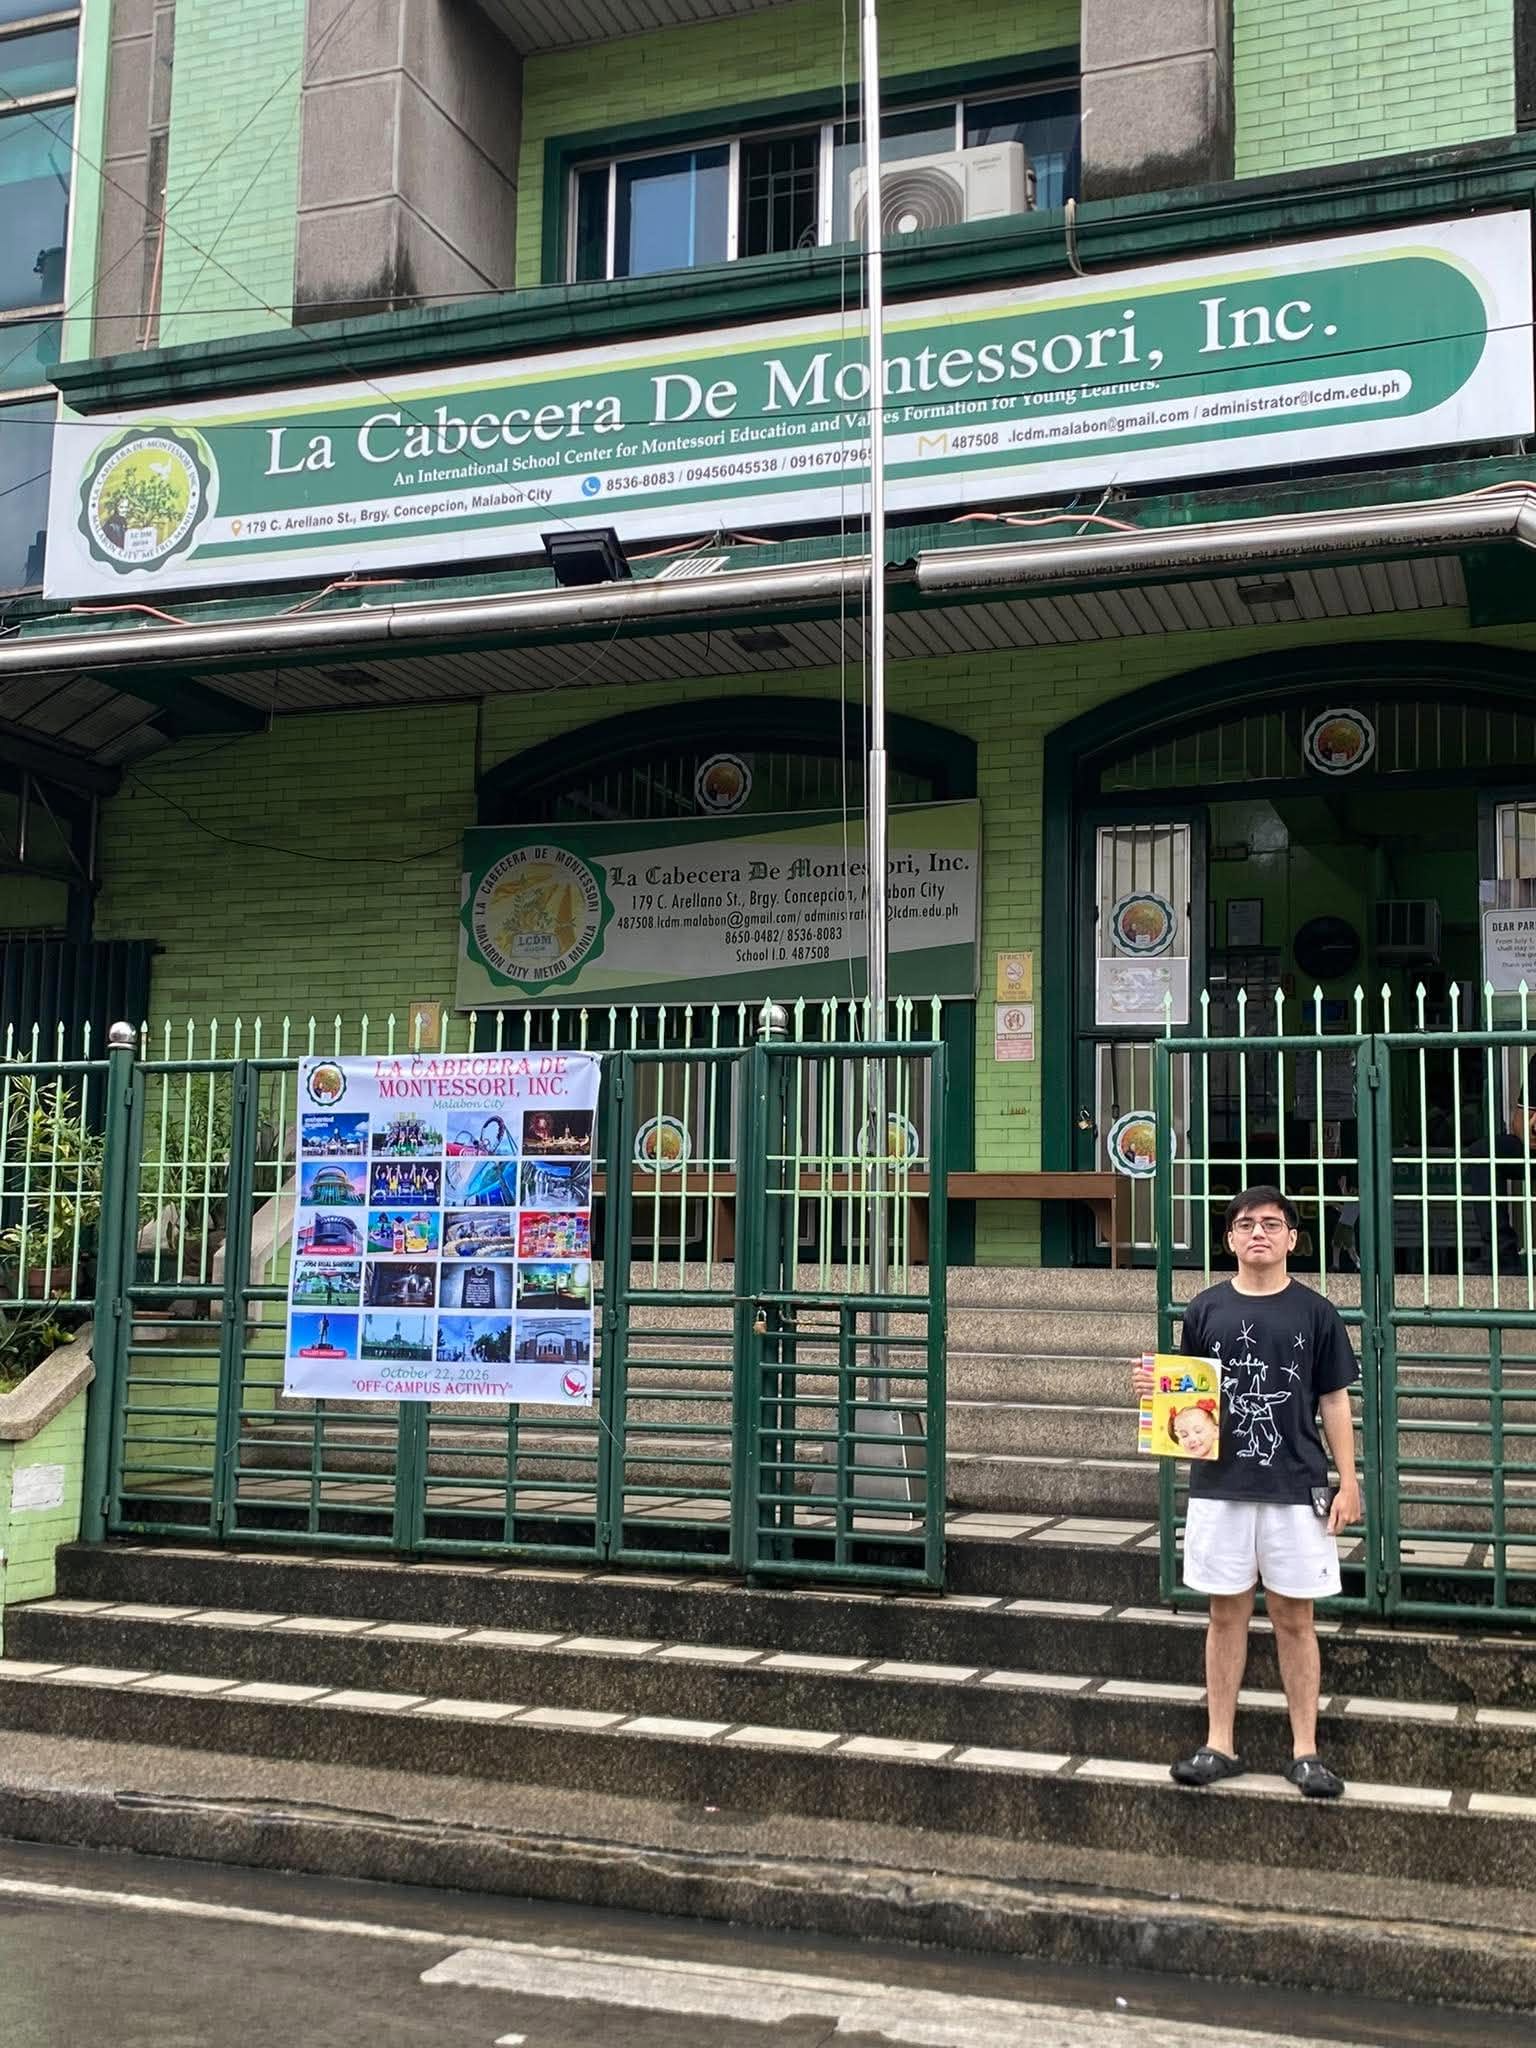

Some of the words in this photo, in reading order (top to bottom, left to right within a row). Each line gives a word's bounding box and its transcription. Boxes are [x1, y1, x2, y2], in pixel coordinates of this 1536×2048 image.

[264, 427, 335, 475] La
[357, 395, 625, 463] Cabecera
[649, 374, 738, 426] De
[762, 309, 1164, 411] Montessori,
[1198, 297, 1338, 352] Inc.
[952, 432, 999, 449] 487508
[1201, 380, 1400, 419] administrator@lcdm.edu.ph
[393, 471, 414, 487] An
[418, 458, 508, 483] International
[512, 452, 560, 472] School
[564, 448, 613, 466] Center
[616, 442, 638, 458] for
[641, 430, 726, 455] Montessori
[730, 419, 806, 444] Education
[810, 416, 840, 433] and
[844, 411, 900, 429] Vales
[904, 399, 987, 422] Formation
[992, 395, 1017, 410] for
[1022, 388, 1077, 407] Young
[1081, 379, 1160, 399] Learners.
[606, 472, 675, 491] 8536-8083
[686, 459, 778, 482] 09456045538
[246, 521, 267, 534] 179
[270, 519, 282, 531] C.
[285, 514, 334, 530] Arellano
[337, 512, 357, 525] St.,
[360, 508, 390, 524] Brgy.
[394, 499, 468, 520] Concepcion,
[471, 491, 524, 509] Malabon
[527, 488, 552, 503] City
[534, 847, 548, 859] DE
[480, 850, 527, 895] CABECERA
[555, 851, 600, 912] MONTESSORI
[610, 866, 638, 887] La
[645, 866, 741, 885] Cabecera
[748, 860, 781, 881] De
[787, 853, 920, 880] Montesori,
[928, 852, 970, 873] Inc.
[475, 902, 486, 916] LA
[632, 895, 653, 911] 179
[657, 894, 668, 910] C.
[672, 892, 722, 909] Arellano
[726, 891, 745, 908] St.,
[750, 890, 780, 909] Brgy.
[784, 888, 858, 906] Concepcion,
[861, 883, 915, 901] Mabon
[920, 881, 945, 901] City
[517, 934, 552, 947] LCDM
[787, 927, 842, 942] 8536-8083
[1492, 922, 1515, 932] DEAR
[1518, 921, 1536, 931] PAR
[475, 924, 505, 969] MALABON
[506, 963, 529, 980] CITY
[534, 959, 568, 980] METRO
[570, 925, 597, 963] MANILA
[736, 949, 769, 963] School
[772, 948, 788, 961] I.D.
[791, 946, 830, 960] 487508
[374, 1061, 402, 1078] LA
[411, 1056, 532, 1078] CABECERA
[539, 1056, 569, 1075] DE
[379, 1077, 521, 1098] MONTESSORI,
[527, 1076, 569, 1096] INC.
[380, 1367, 431, 1380] October
[458, 1369, 490, 1381] 2026
